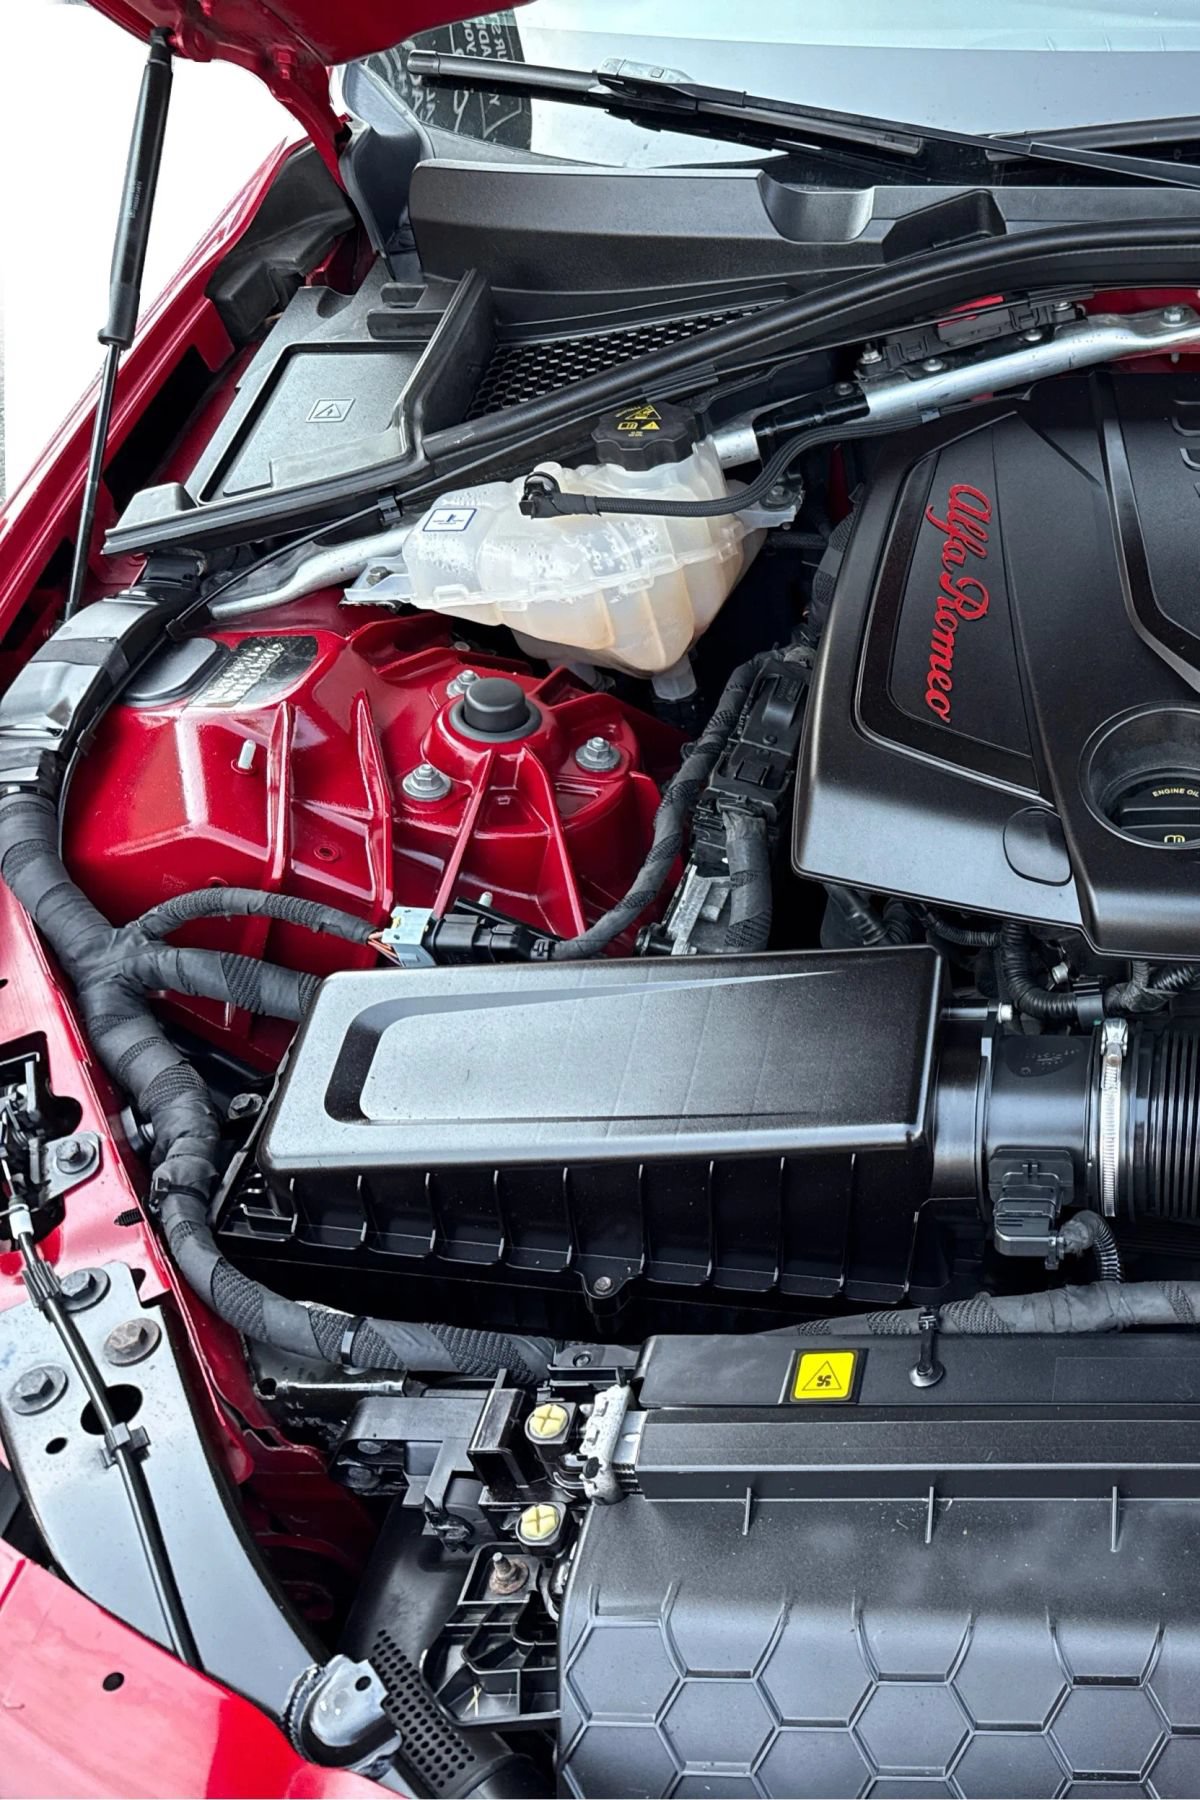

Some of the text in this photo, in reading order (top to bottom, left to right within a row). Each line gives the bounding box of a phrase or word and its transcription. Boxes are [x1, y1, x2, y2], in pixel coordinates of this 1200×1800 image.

[925, 484, 992, 723] Alfa Romeo
[1152, 787, 1199, 798] ENGINE OIL
